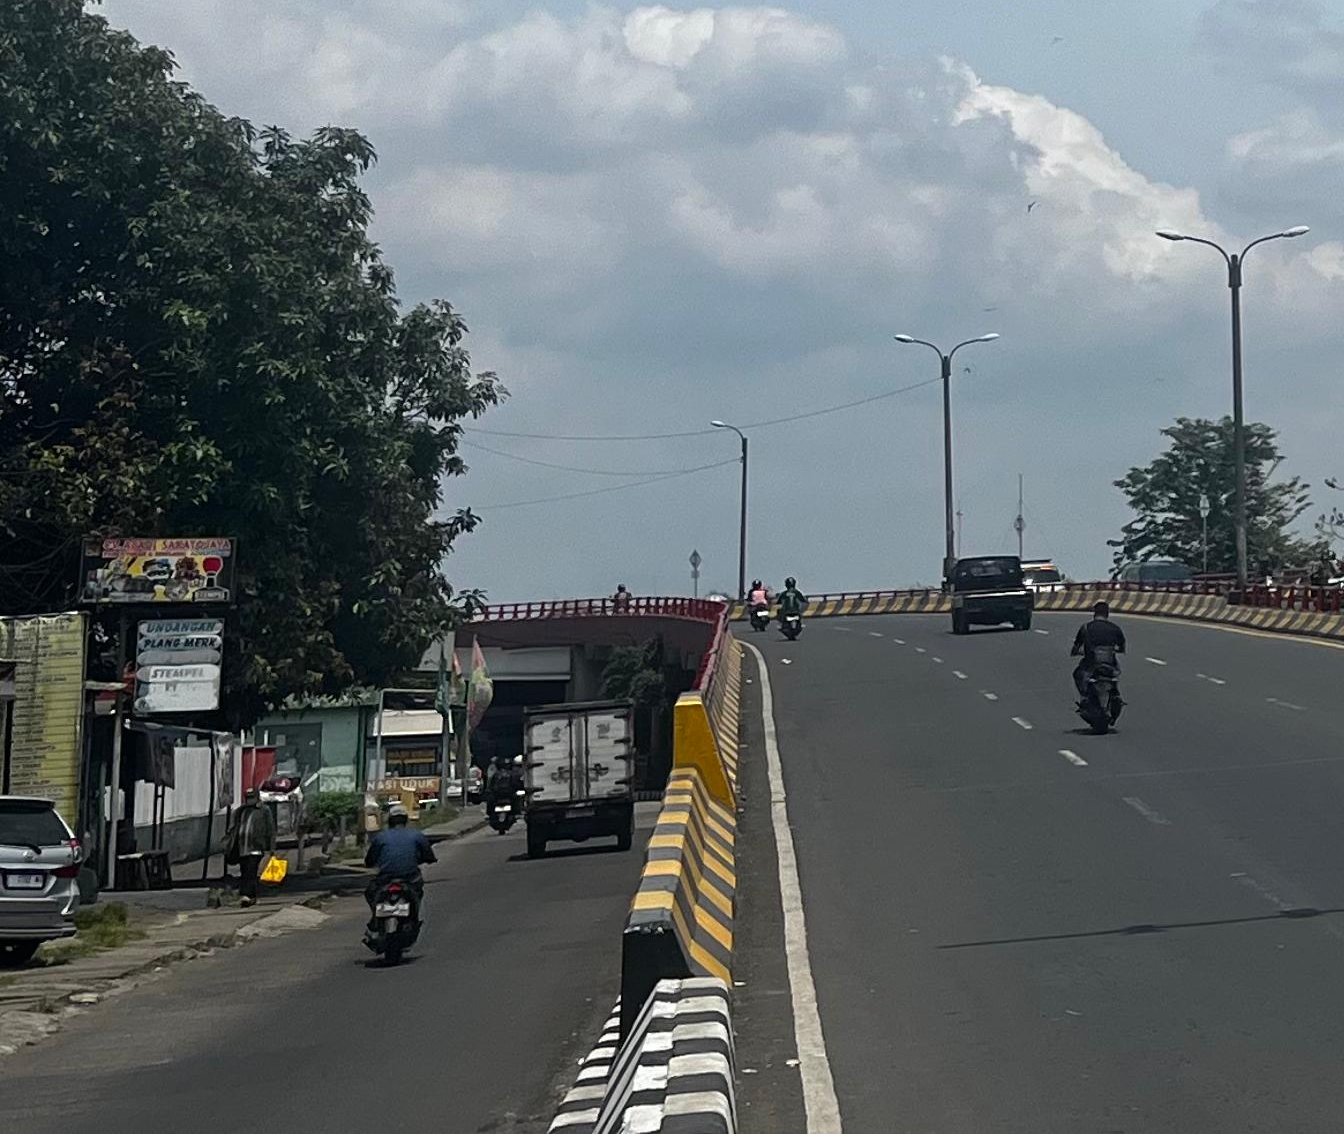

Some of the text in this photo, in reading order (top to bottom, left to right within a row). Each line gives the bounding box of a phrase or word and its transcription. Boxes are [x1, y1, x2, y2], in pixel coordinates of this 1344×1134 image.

[146, 623, 217, 633] UNDANGAN
[144, 637, 217, 648] PLANG MERK
[367, 779, 434, 792] NASI UDUK
